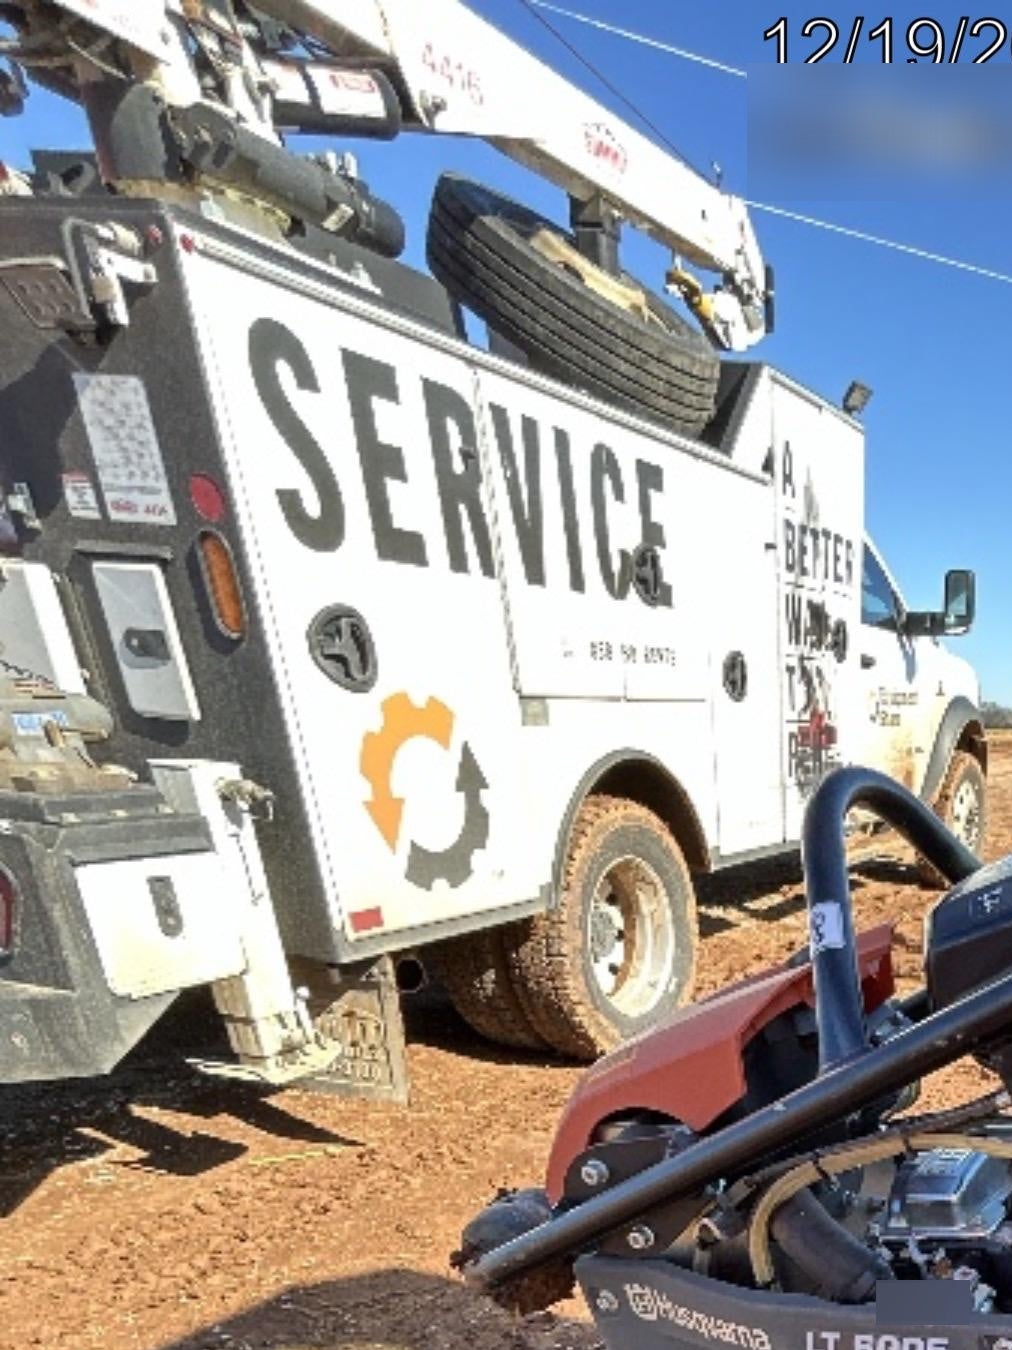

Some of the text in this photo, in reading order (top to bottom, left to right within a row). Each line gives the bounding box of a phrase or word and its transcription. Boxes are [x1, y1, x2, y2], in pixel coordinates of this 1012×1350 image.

[248, 316, 674, 608] SERVICE
[782, 440, 797, 499] A
[783, 517, 856, 586] BETTER
